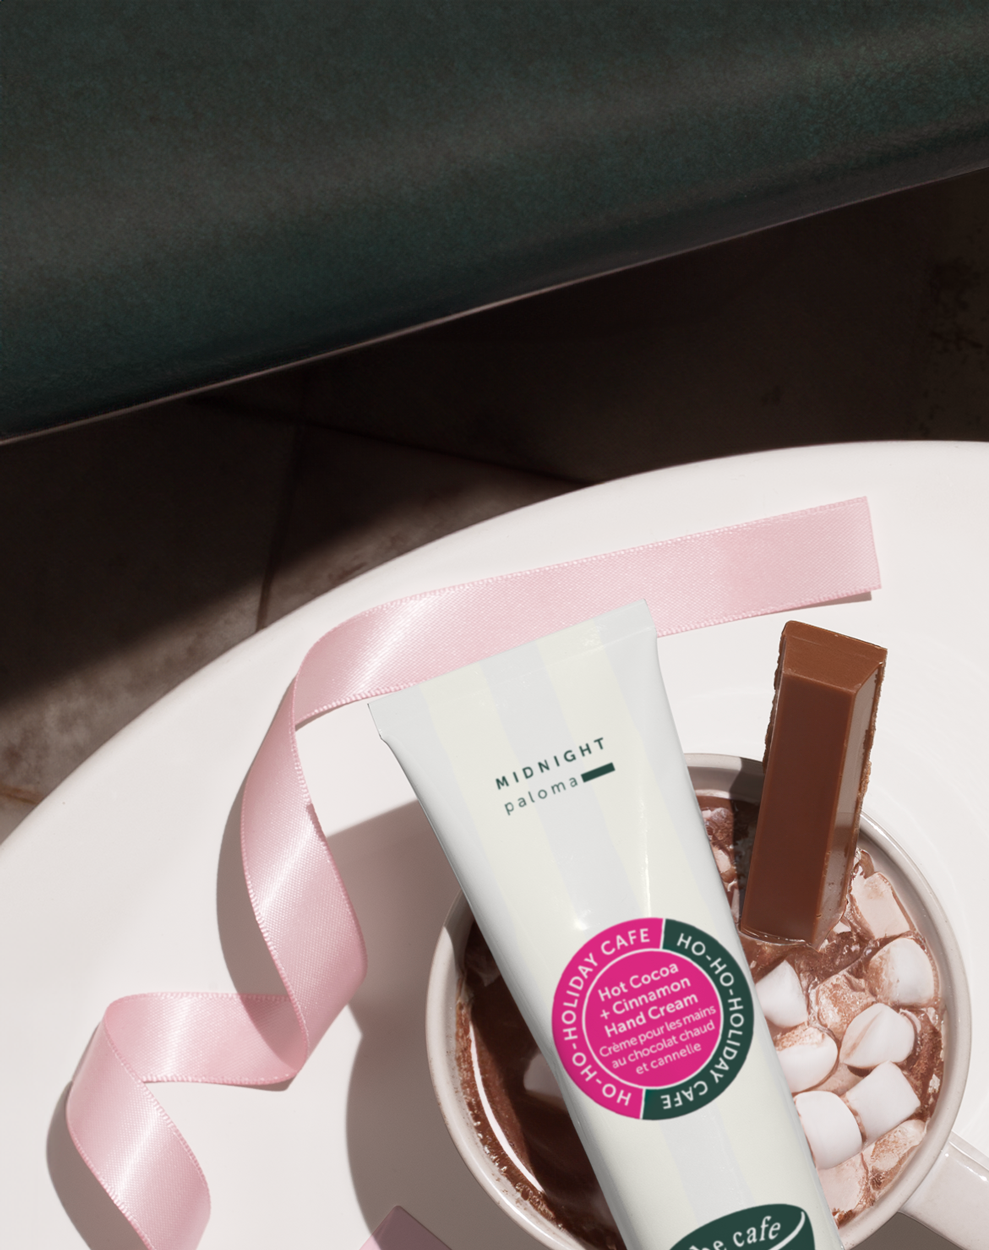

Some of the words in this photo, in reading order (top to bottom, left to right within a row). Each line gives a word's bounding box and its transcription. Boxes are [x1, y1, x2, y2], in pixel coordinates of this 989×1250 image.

[495, 737, 604, 790] MIDNIGHT
[504, 777, 578, 815] paloma
[598, 981, 628, 1001] Hot
[629, 963, 679, 988] Cocoa
[600, 1009, 610, 1020] +
[612, 977, 691, 1015] Cinnamon
[561, 953, 632, 1106] HO-HO-HOLIDAY
[600, 928, 650, 956] CAFE
[604, 1012, 646, 1038] Hand
[648, 993, 698, 1020] Cream
[676, 933, 744, 1084] HO-HO-HOLIDAY
[599, 1037, 638, 1057] Crème
[639, 1026, 665, 1046] pour
[665, 1017, 682, 1031] les
[682, 1005, 716, 1026] mains
[611, 1057, 627, 1069] au
[628, 1035, 679, 1063] chocolat
[679, 1020, 716, 1042] chaud
[635, 1063, 649, 1075] et
[650, 1042, 702, 1069] cannelle
[660, 1080, 708, 1109] CAFE
[732, 1215, 781, 1248] cafe
